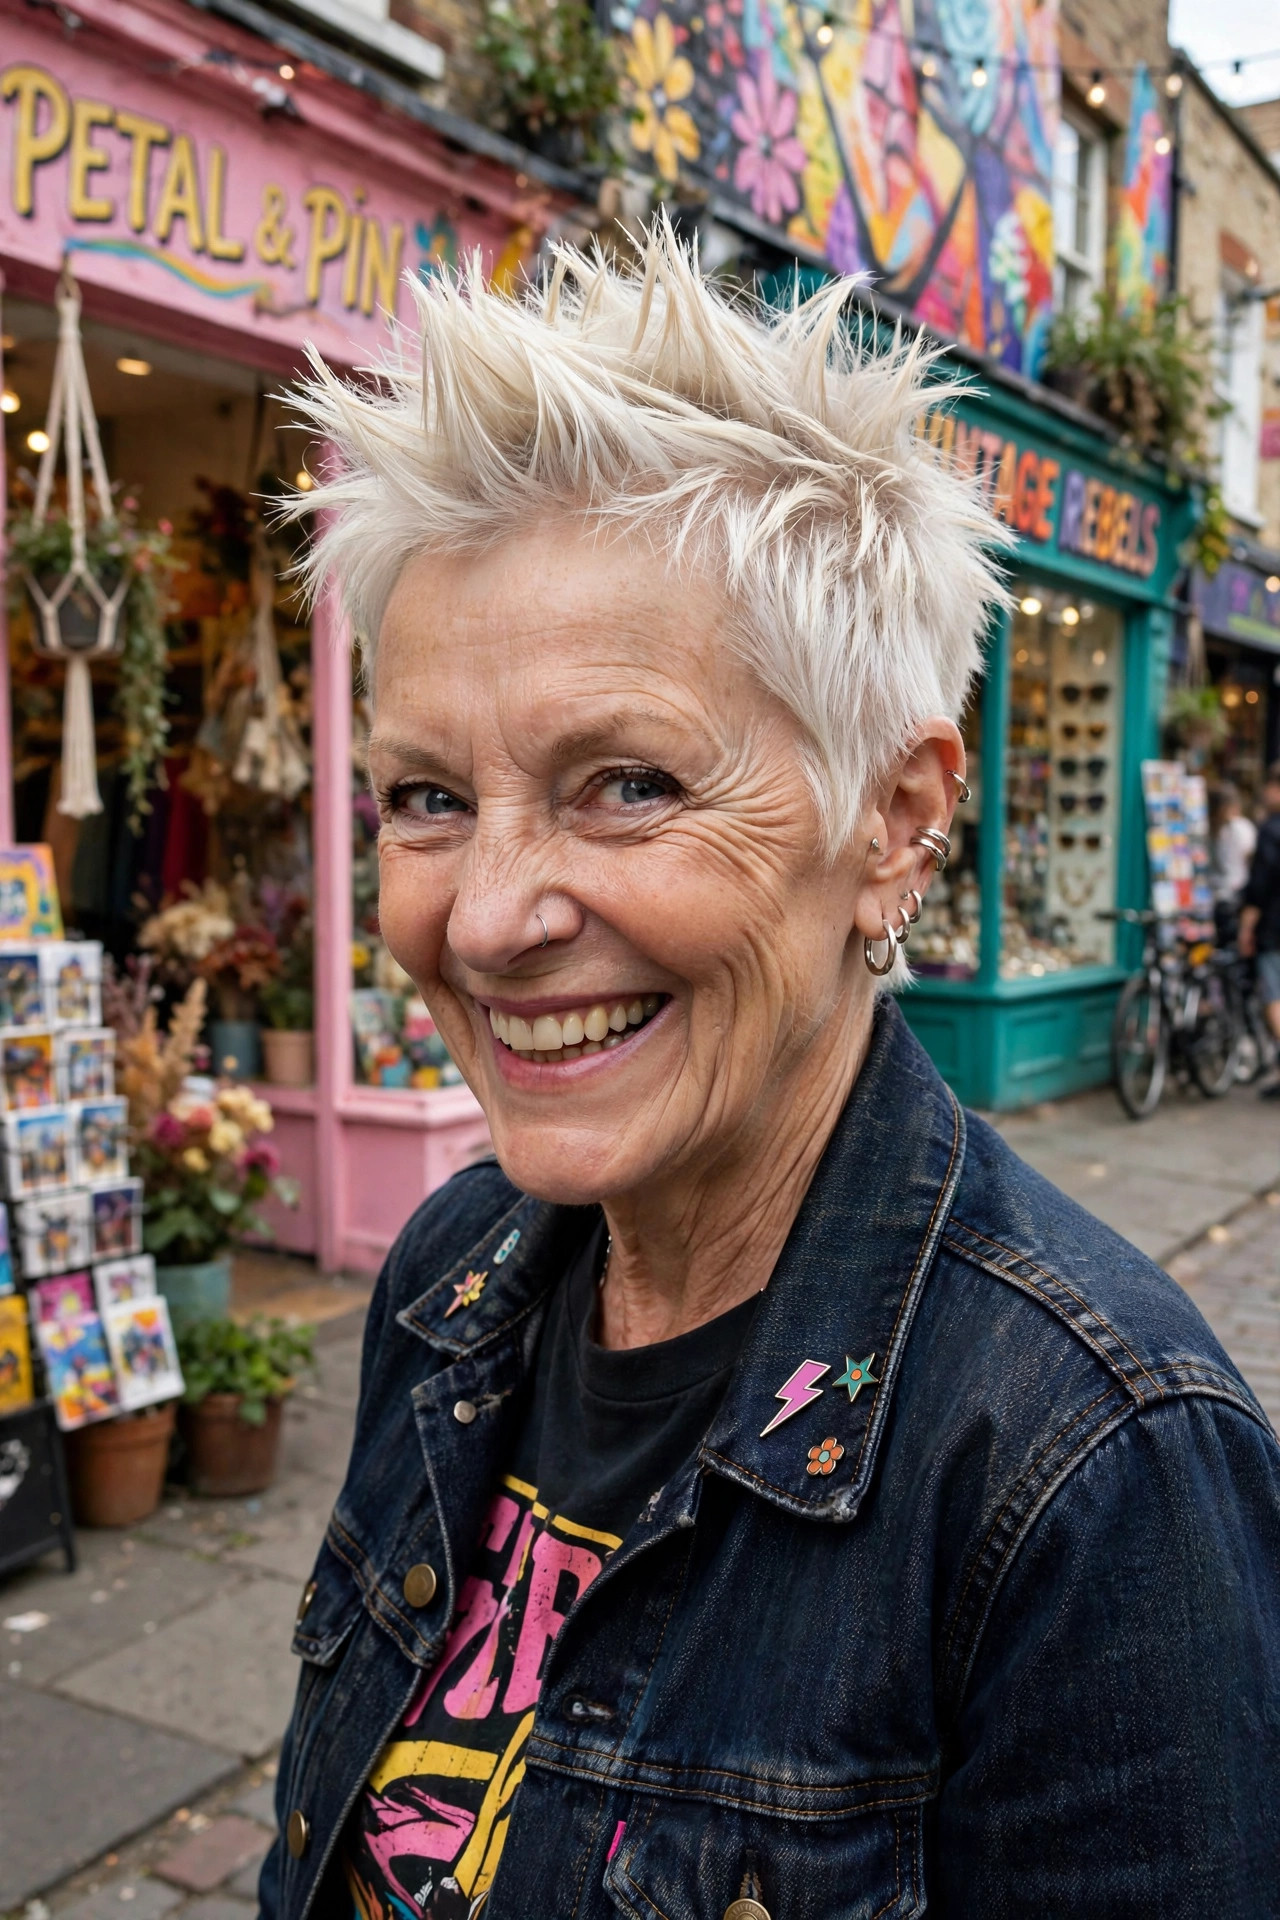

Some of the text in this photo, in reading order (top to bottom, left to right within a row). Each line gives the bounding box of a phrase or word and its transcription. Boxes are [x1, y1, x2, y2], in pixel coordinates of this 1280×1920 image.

[2, 64, 245, 261] PETAL
[256, 184, 295, 269] &
[1060, 470, 1160, 577] REBELS
